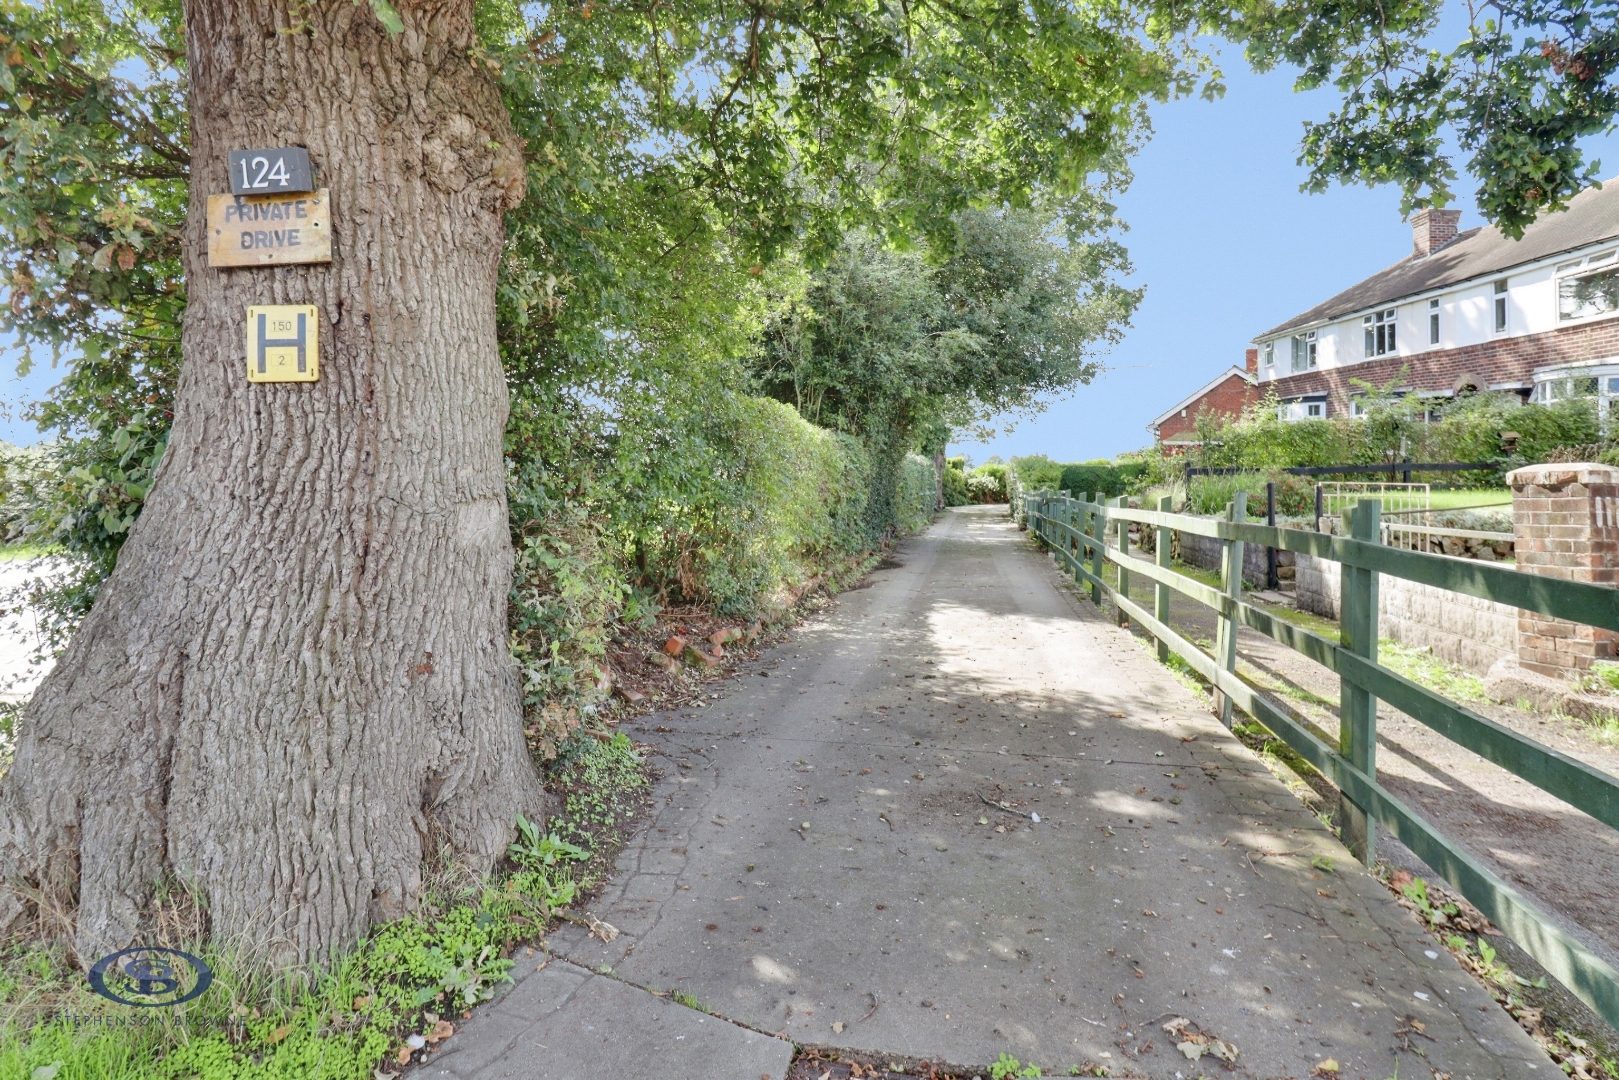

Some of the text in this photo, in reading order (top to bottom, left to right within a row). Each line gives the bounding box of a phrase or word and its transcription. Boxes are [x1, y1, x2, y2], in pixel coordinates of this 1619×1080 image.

[240, 156, 291, 189] 124
[225, 200, 308, 223] PRIVATE
[241, 228, 301, 249] DRIVE
[272, 321, 292, 331] 150
[257, 313, 306, 373] H
[278, 355, 285, 366] 2
